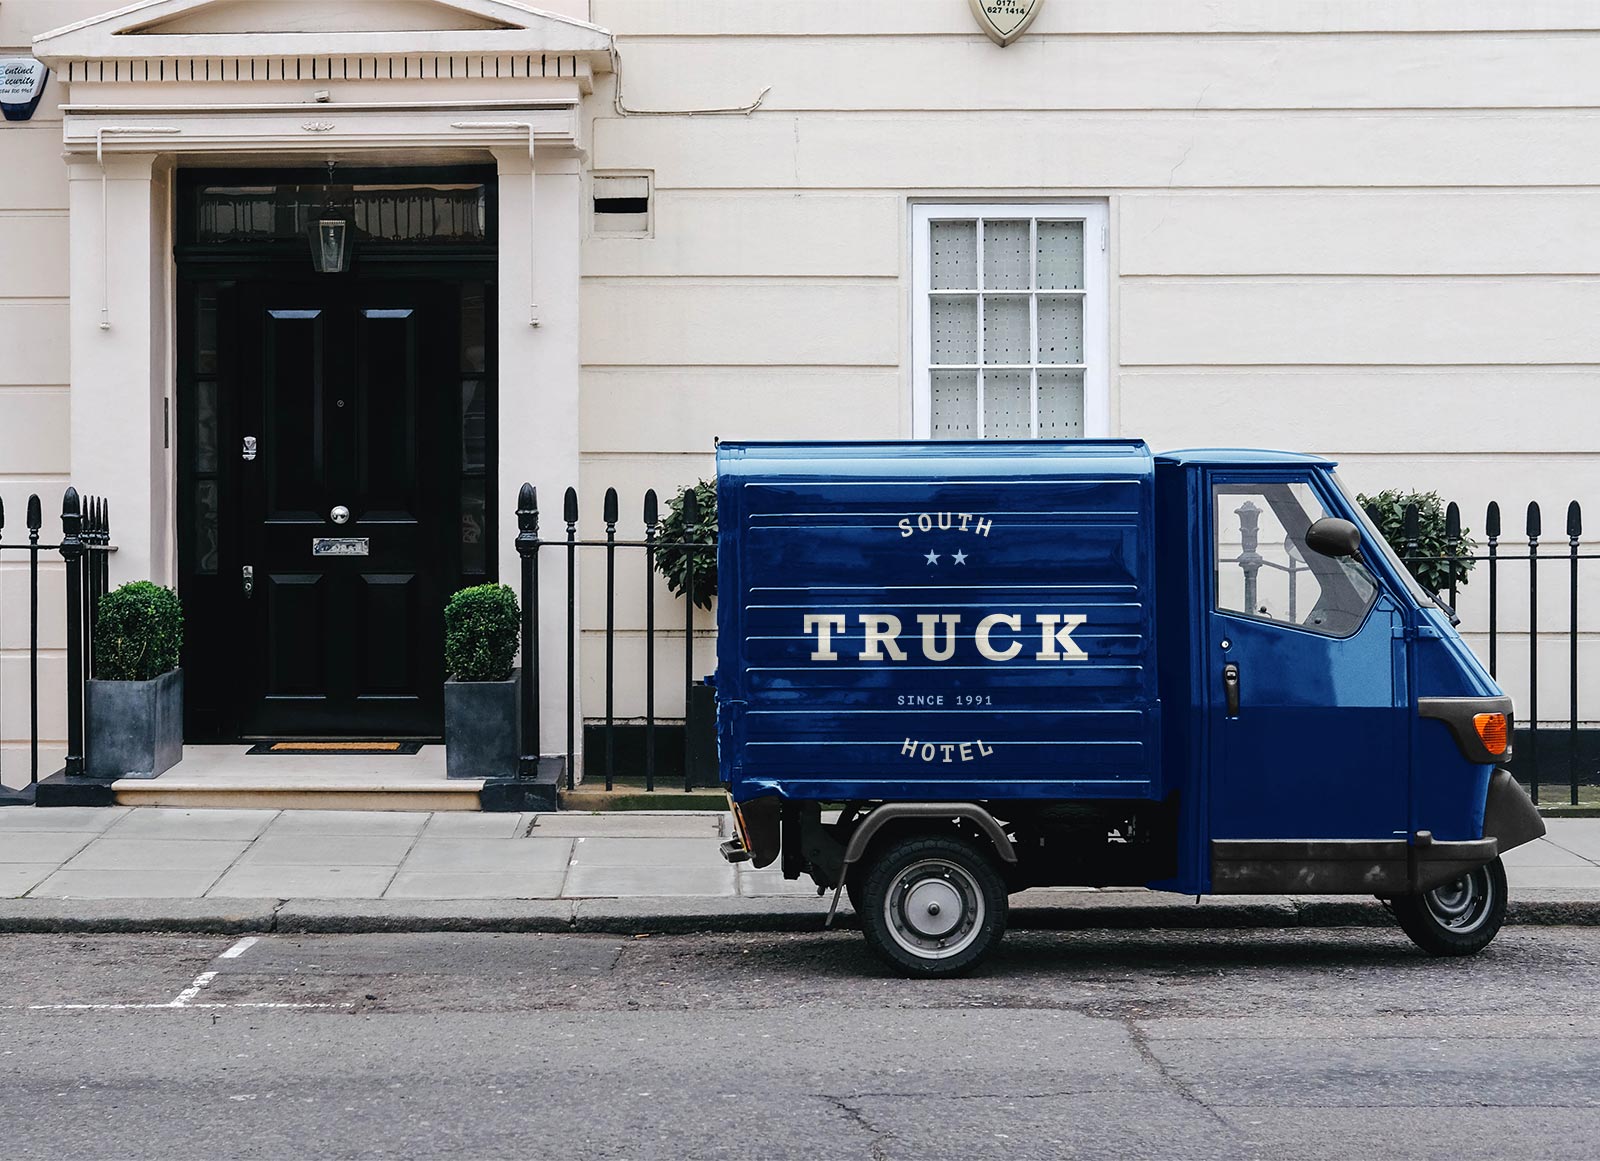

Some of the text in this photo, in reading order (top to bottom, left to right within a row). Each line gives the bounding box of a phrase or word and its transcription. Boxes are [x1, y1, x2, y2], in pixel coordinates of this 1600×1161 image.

[898, 512, 993, 538] SOUTH
[803, 614, 1088, 661] TRUCK
[897, 695, 993, 706] SINCE 1991
[901, 738, 994, 763] HOTEL
